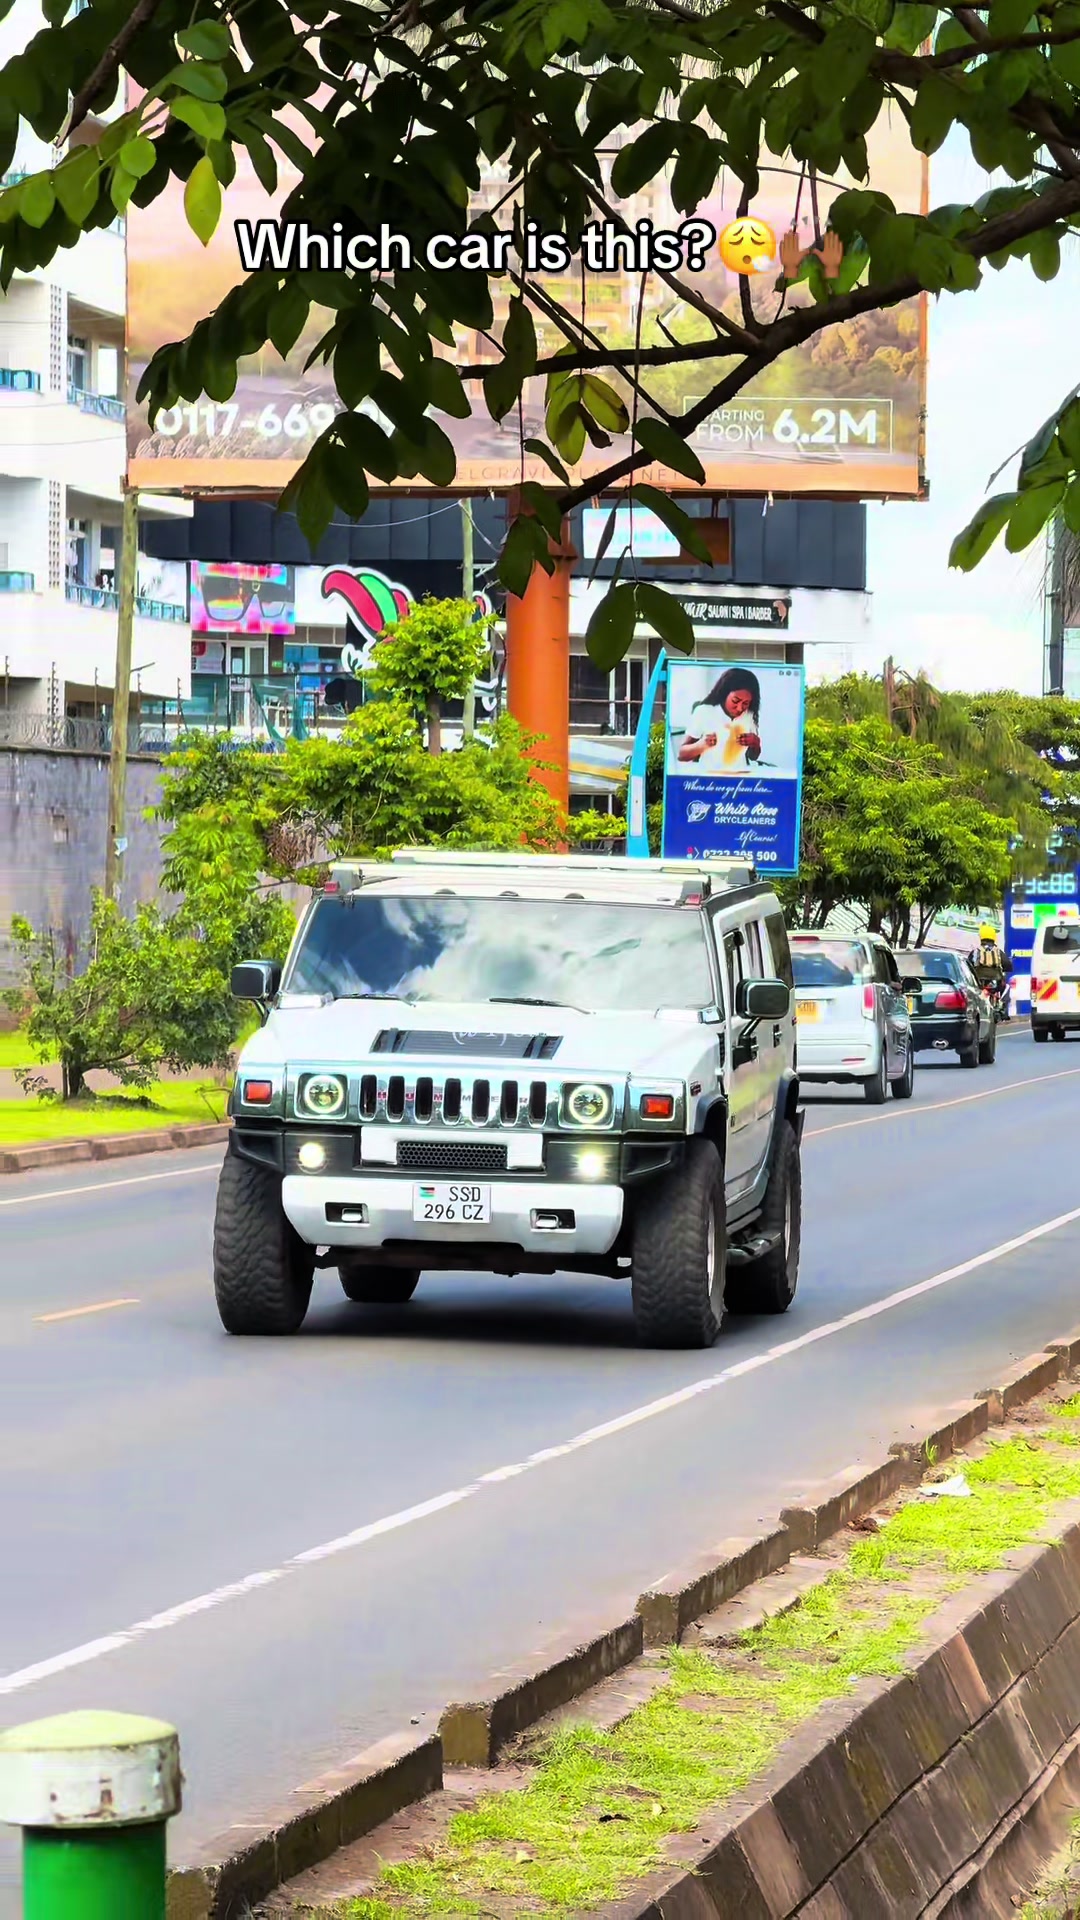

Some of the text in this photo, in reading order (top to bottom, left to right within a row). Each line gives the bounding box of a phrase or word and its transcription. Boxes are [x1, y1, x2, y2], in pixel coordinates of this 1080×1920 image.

[711, 409, 764, 422] ARTING
[696, 408, 877, 444] FROM 6.2M
[708, 604, 728, 619] SALON
[731, 606, 744, 620] SPA
[748, 607, 772, 621] BARBER
[714, 801, 779, 816] White Rose
[714, 816, 776, 825] DRYCLEANERS
[755, 850, 778, 861] 500
[377, 1090, 529, 1104] HUMMER
[448, 1186, 481, 1203] SSD
[424, 1204, 484, 1221] 296 CZ
